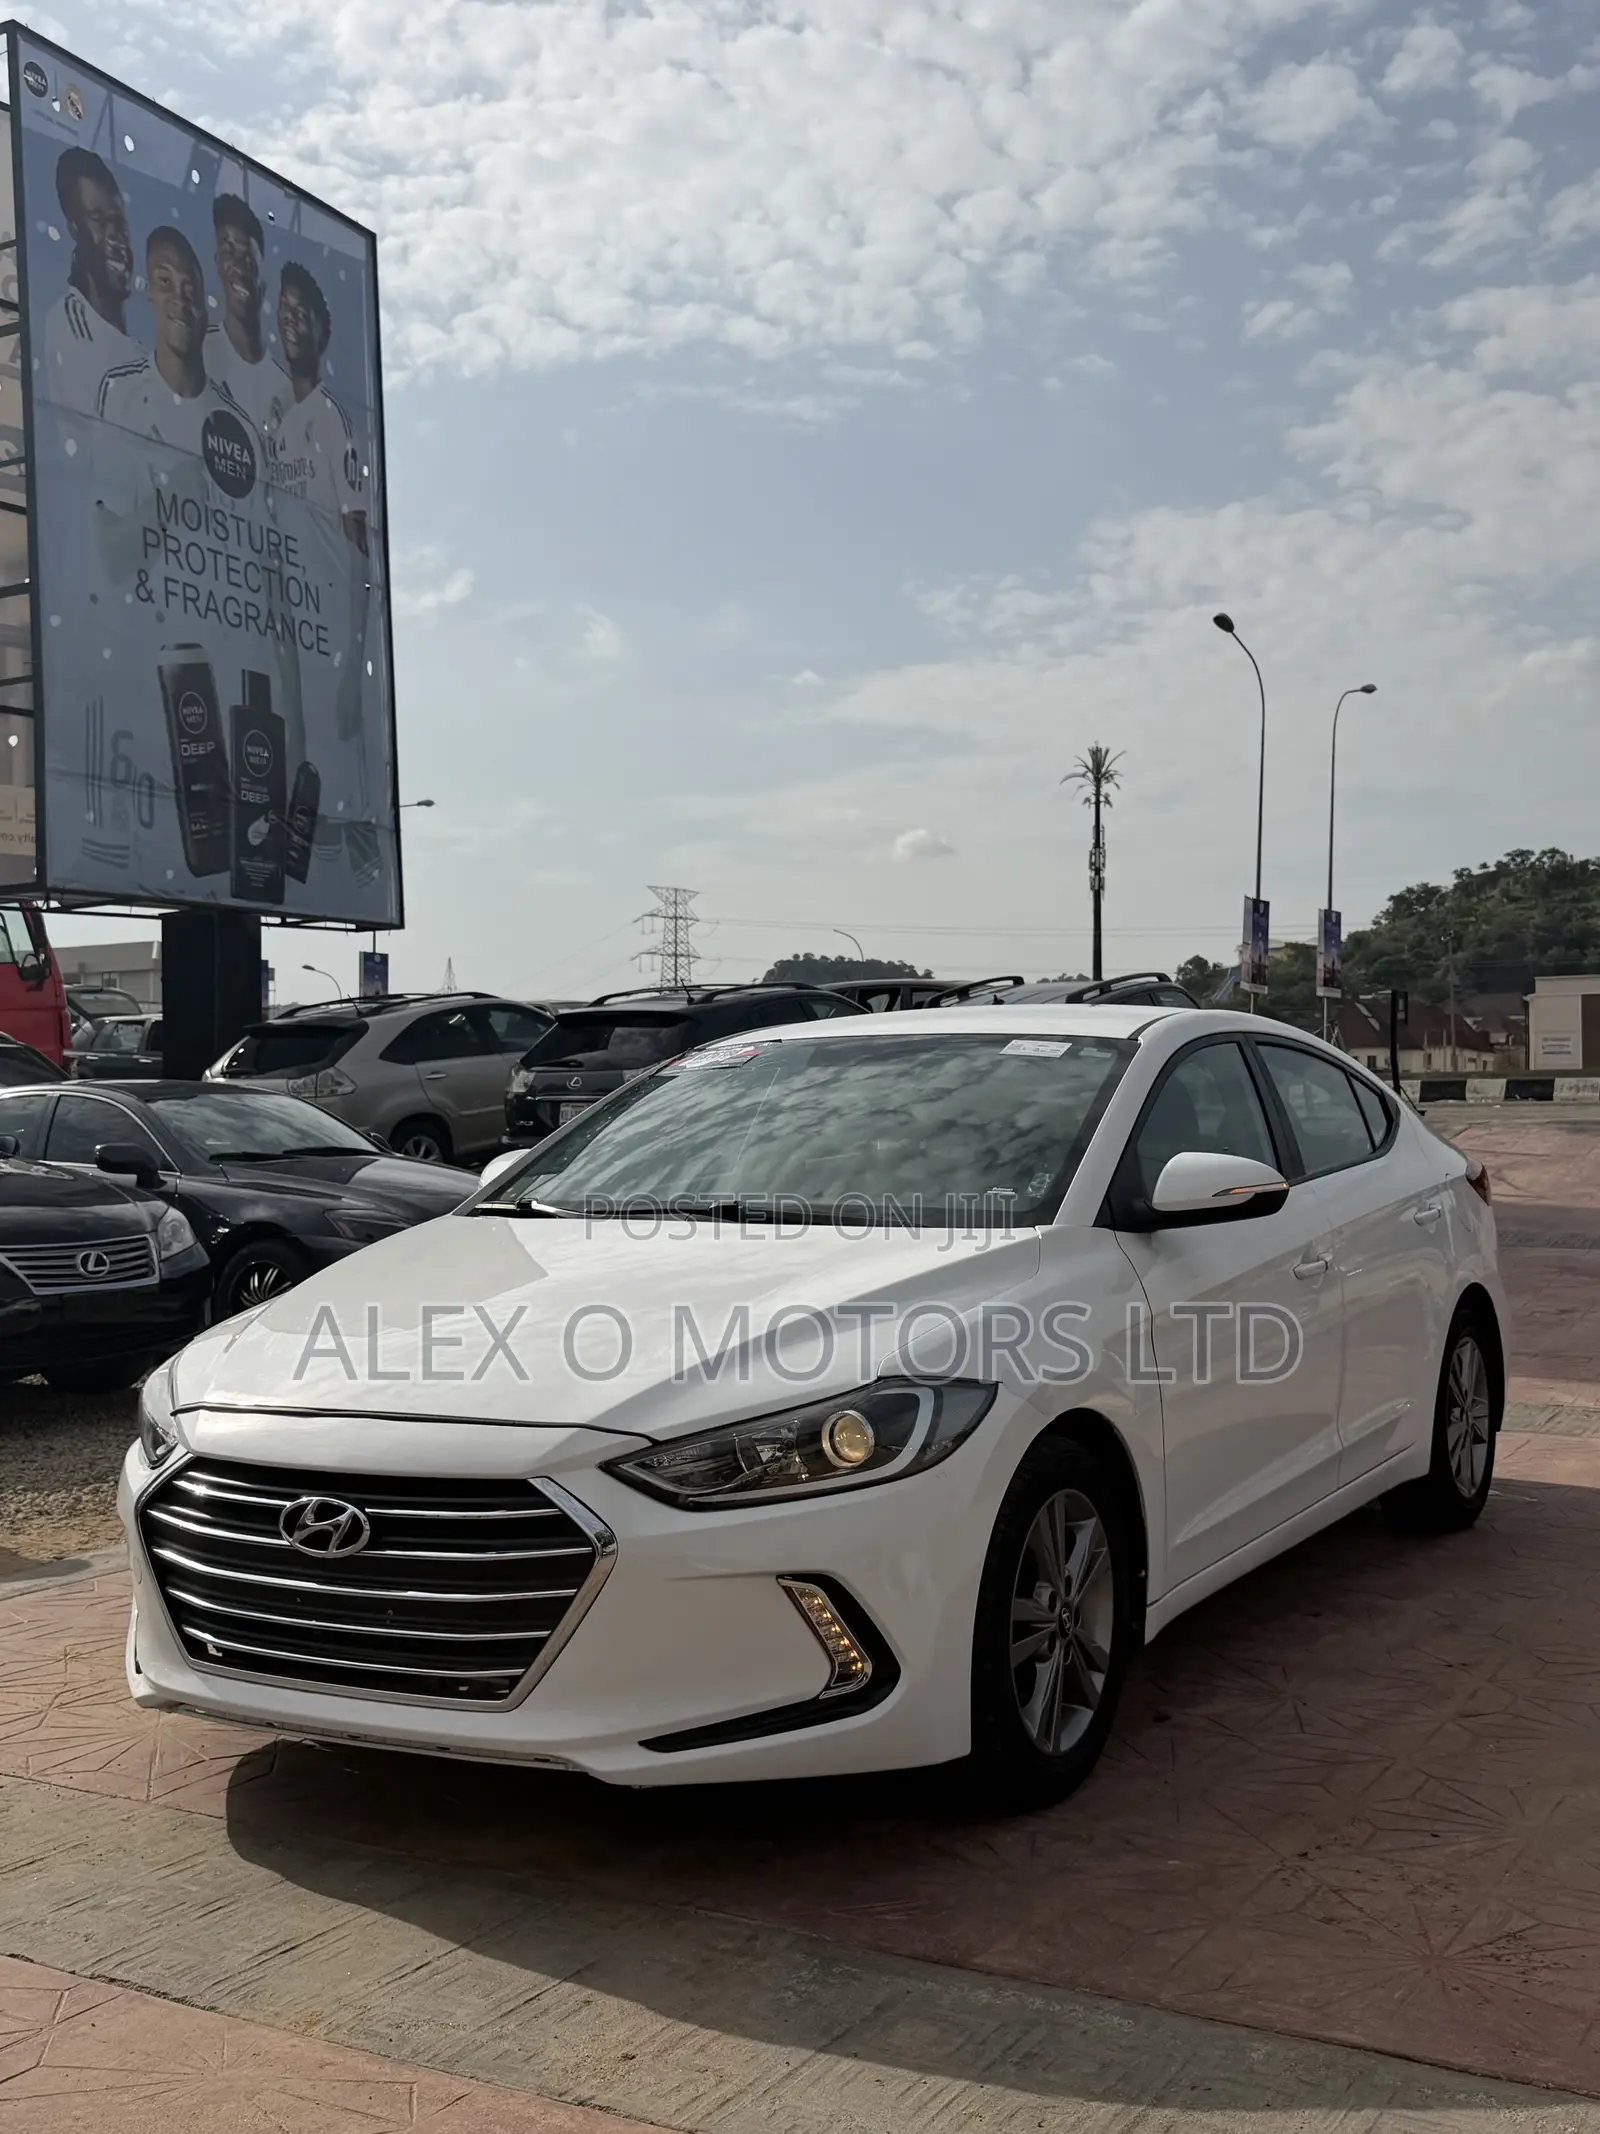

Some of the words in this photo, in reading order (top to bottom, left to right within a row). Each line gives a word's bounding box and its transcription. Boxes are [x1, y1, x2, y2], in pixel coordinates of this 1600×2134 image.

[207, 433, 251, 466] NIVEA
[214, 455, 247, 481] MEN
[156, 487, 306, 576] MOISTURE,
[142, 526, 321, 615] PROTECTION
[135, 568, 156, 605] &
[164, 576, 331, 657] FRAGRANCE
[180, 740, 216, 757] DEEP
[240, 789, 271, 804] DEEP
